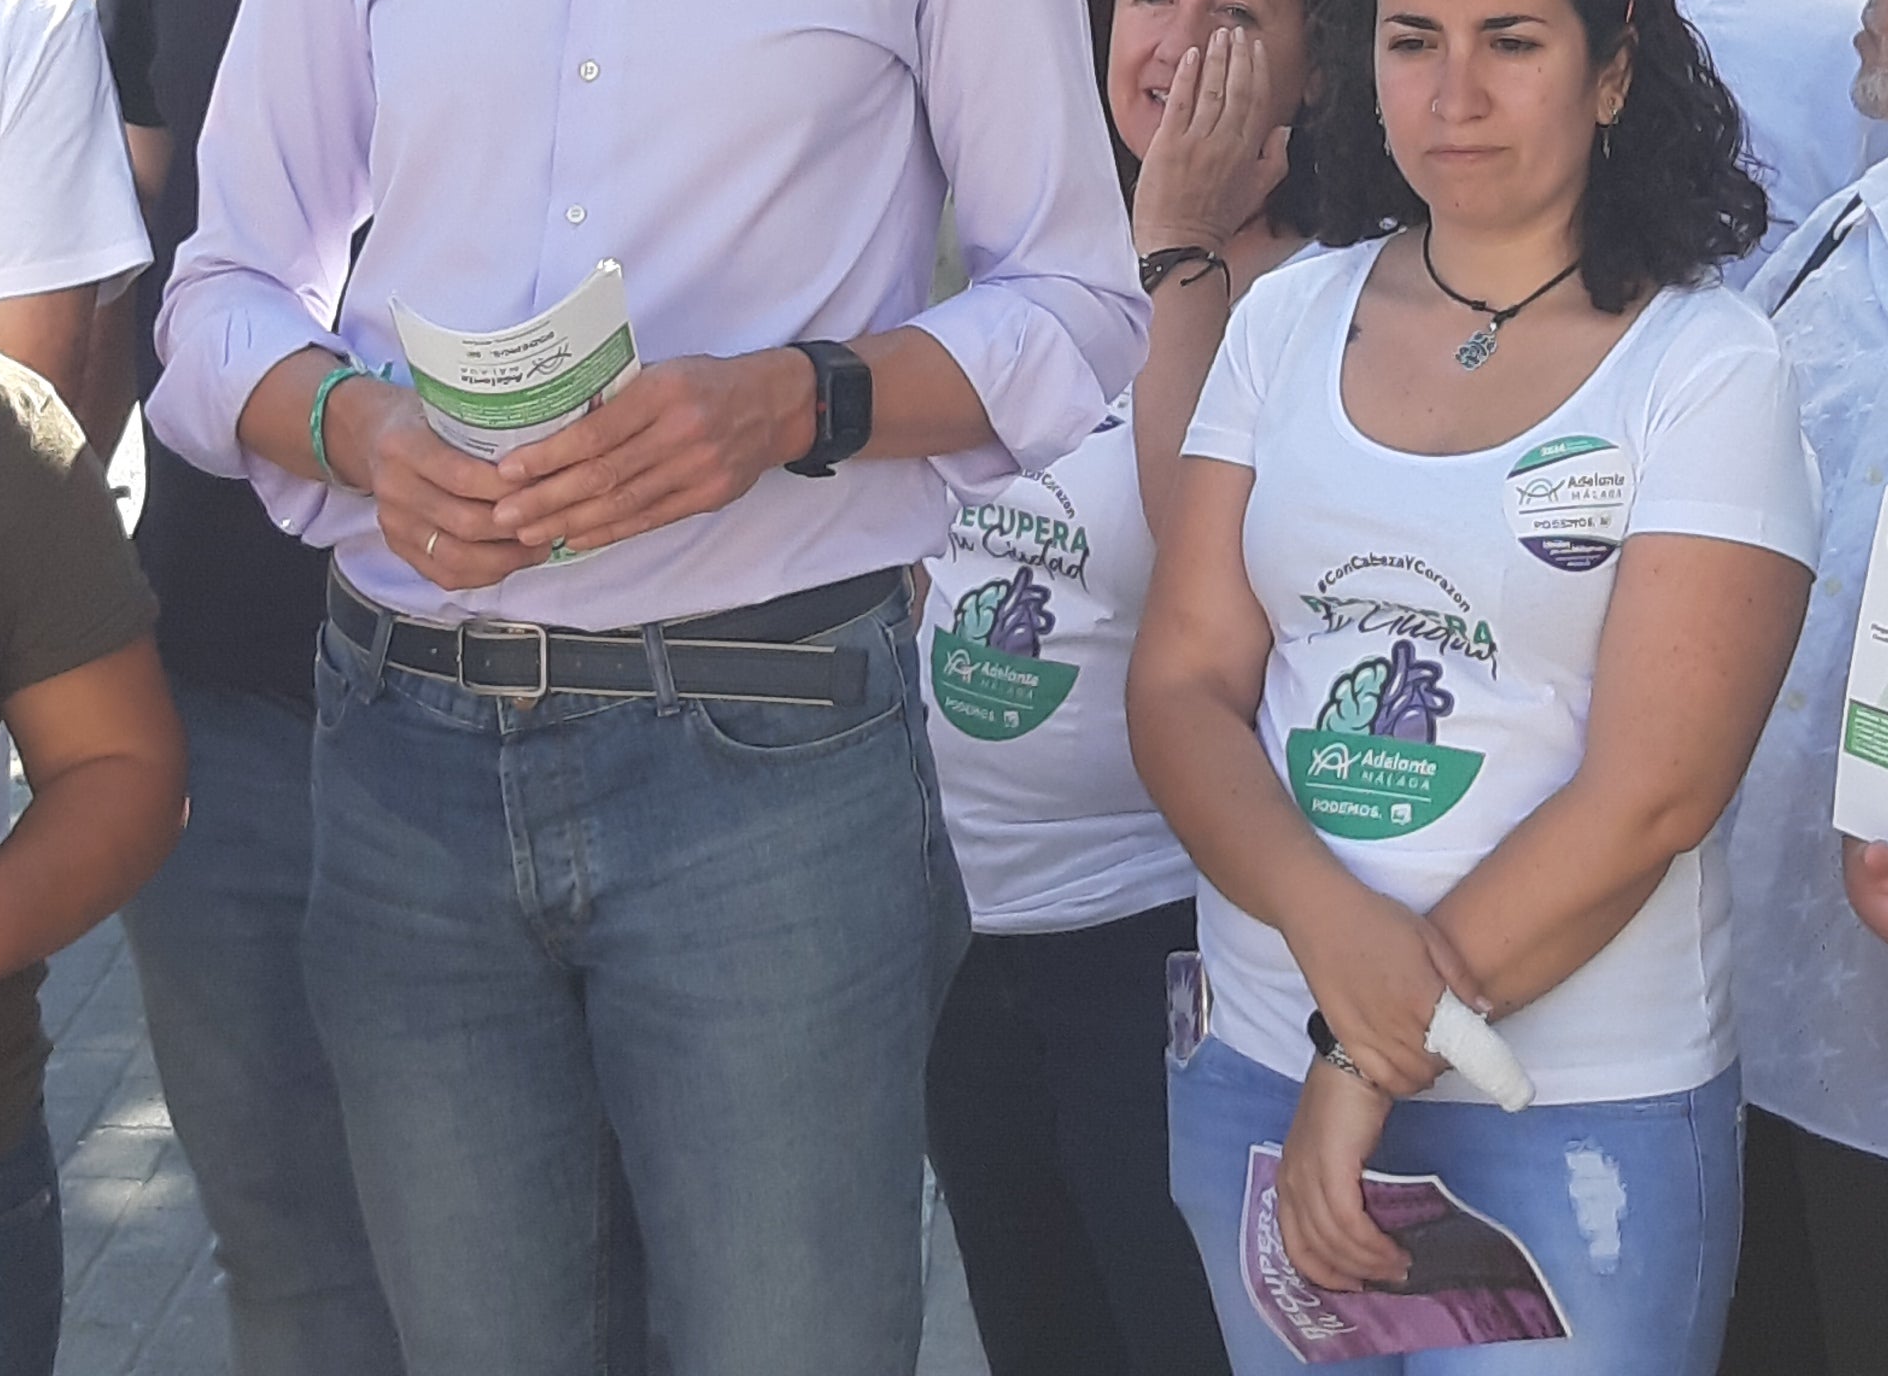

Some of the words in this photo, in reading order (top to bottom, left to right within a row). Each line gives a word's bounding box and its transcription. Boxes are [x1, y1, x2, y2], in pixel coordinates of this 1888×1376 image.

[960, 503, 1089, 554] ECUPERA
[1361, 748, 1438, 777] Adelante
[1361, 770, 1431, 792] MÁLAGA
